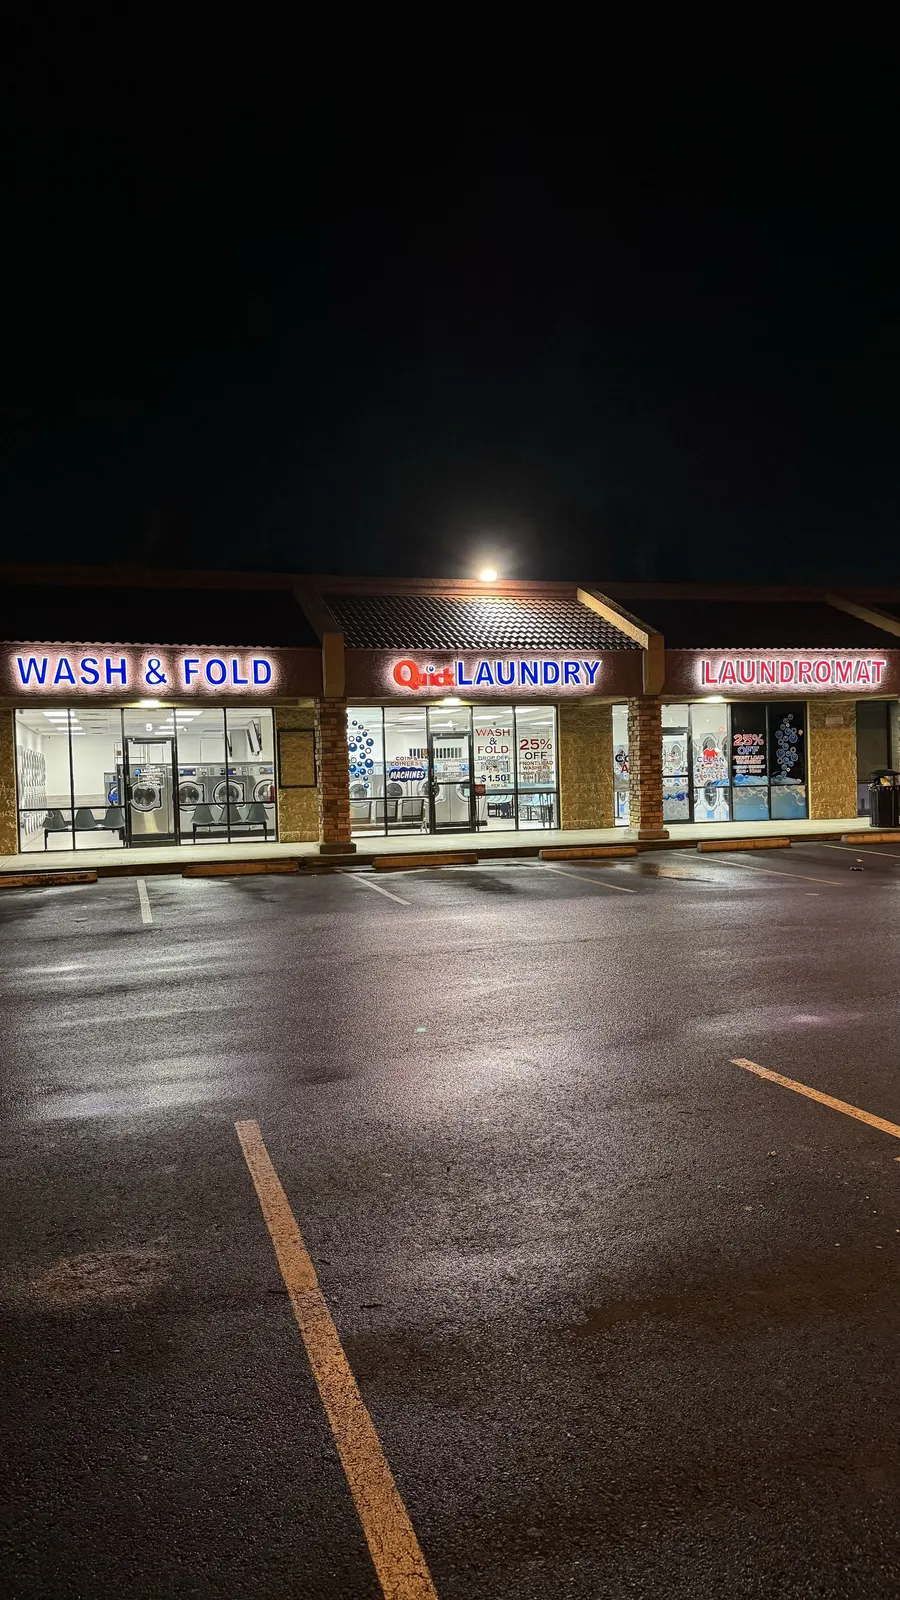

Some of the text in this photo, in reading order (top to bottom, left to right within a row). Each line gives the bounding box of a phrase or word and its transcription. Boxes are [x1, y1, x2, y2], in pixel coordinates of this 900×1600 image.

[16, 656, 273, 686] WASH & FOLD
[392, 659, 603, 691] Quick LAUNDRY
[702, 660, 887, 684] LAUNDROMAT
[475, 728, 511, 737] WASH
[489, 737, 497, 745] &
[519, 738, 553, 750] 25%
[733, 733, 765, 746] 25%
[477, 745, 509, 754] FOLD
[737, 746, 760, 755] OFF
[524, 752, 548, 760] OFF
[389, 770, 425, 779] MACHINES
[481, 774, 507, 782] $1.50
